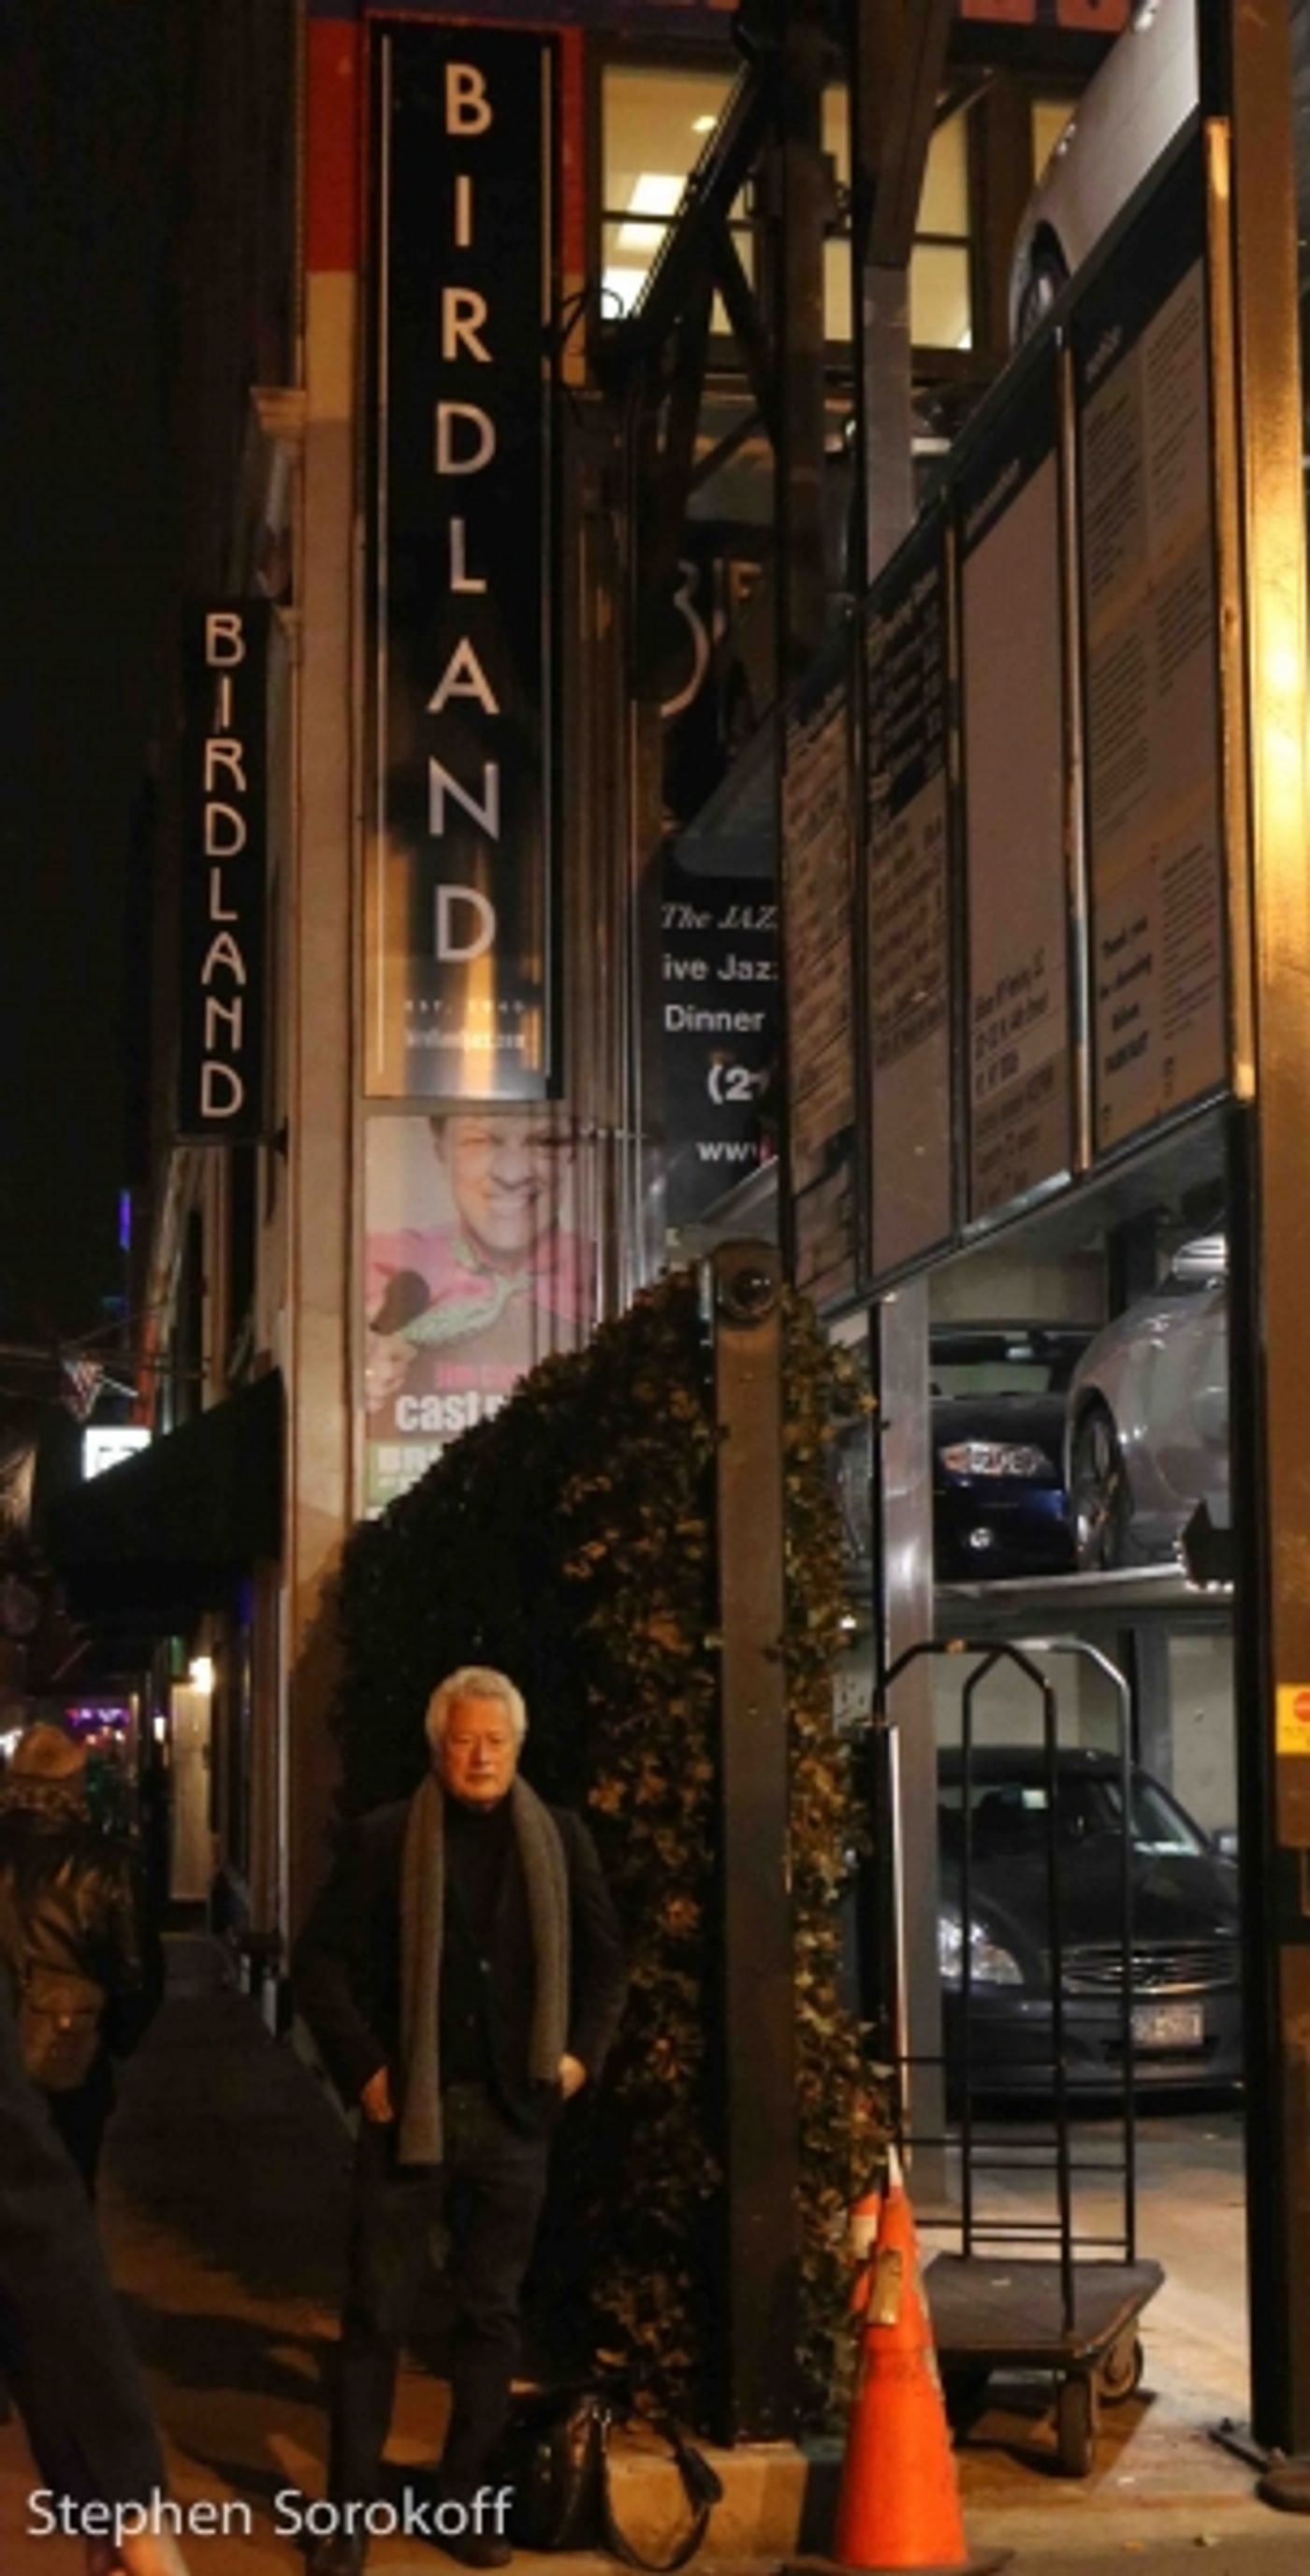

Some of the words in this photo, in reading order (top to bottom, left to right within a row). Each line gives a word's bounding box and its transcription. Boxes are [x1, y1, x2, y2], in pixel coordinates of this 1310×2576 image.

[426, 62, 501, 963] BIRDLAND
[199, 613, 248, 1120] BIRDLAND
[661, 902, 714, 929] The
[717, 904, 779, 930] JAZ
[662, 953, 710, 980] ive
[664, 1004, 766, 1031] Dinner
[707, 1062, 754, 1105] (2
